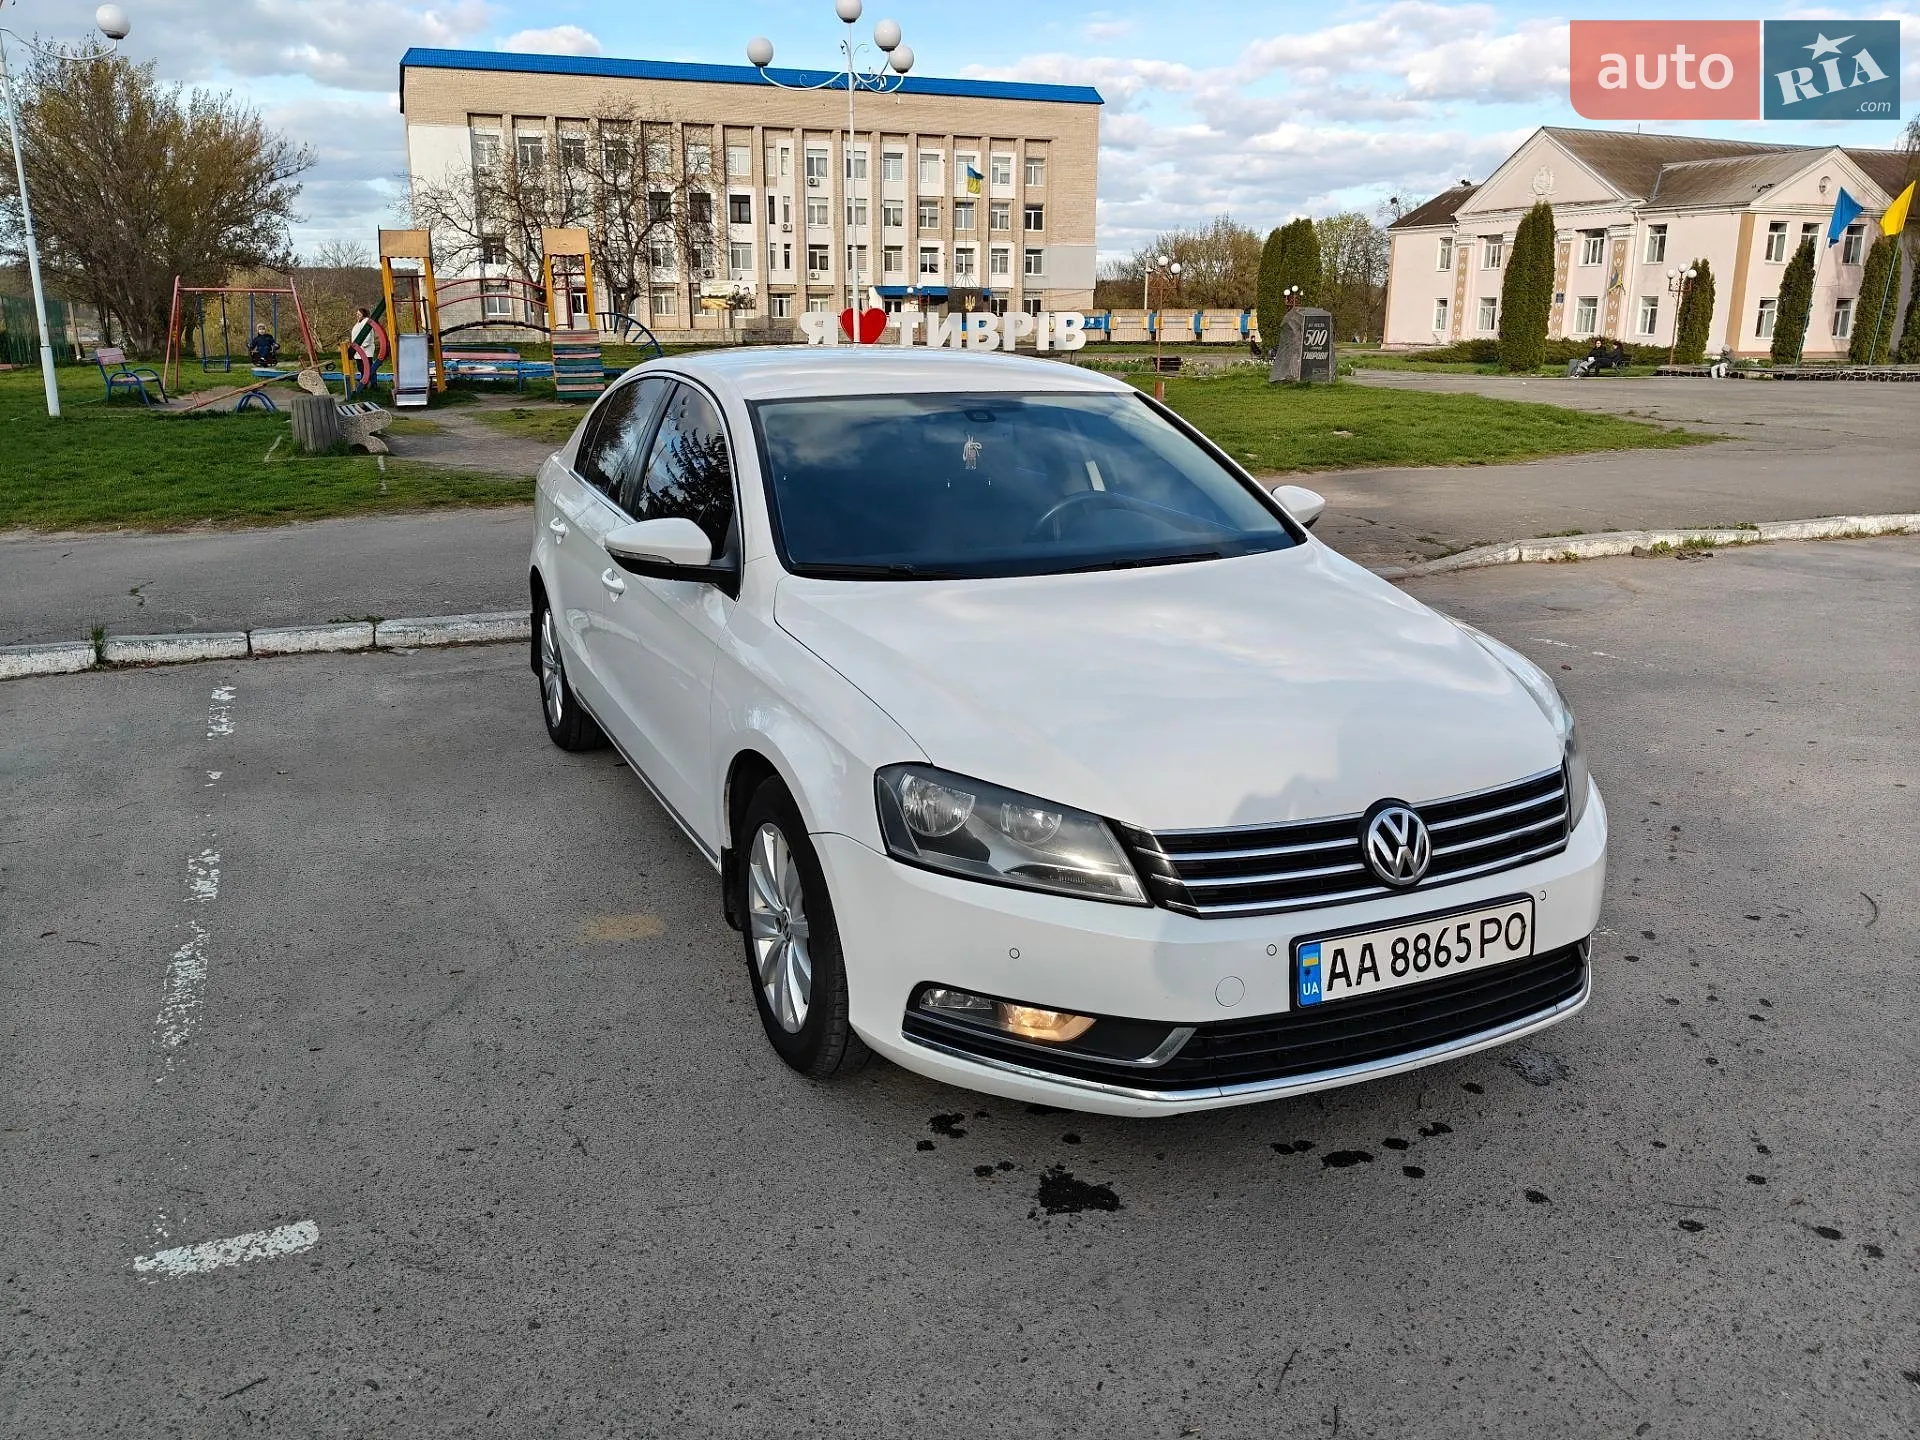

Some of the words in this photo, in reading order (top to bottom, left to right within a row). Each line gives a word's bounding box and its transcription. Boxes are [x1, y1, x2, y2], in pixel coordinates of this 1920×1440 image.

[800, 311, 839, 345] Я
[889, 311, 1087, 351] ТИВРІВ
[1304, 329, 1328, 346] 500
[1326, 942, 1381, 992] AA
[1390, 923, 1472, 978] 8865
[1479, 912, 1527, 959] PO
[1302, 981, 1320, 996] UA
